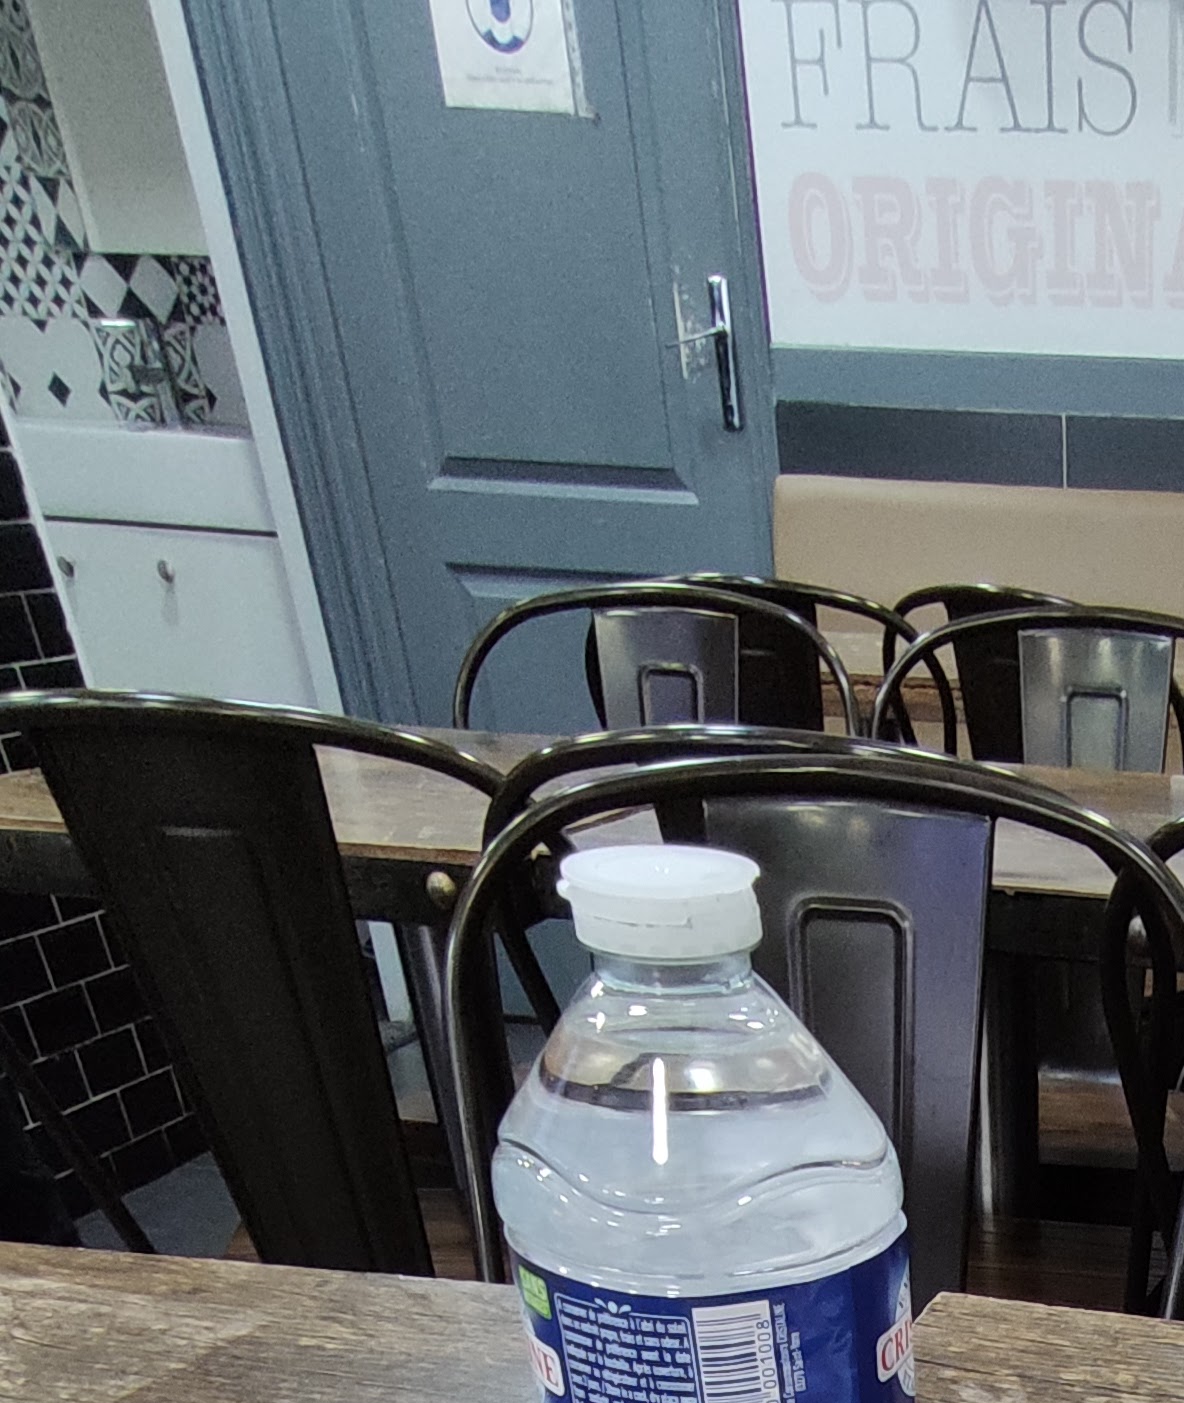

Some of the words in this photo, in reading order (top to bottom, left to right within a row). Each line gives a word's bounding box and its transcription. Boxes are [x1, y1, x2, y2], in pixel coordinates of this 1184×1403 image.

[781, 0, 1138, 135] FRAIS
[756, 1318, 778, 1390] 001008
[881, 1319, 913, 1372] CRI
